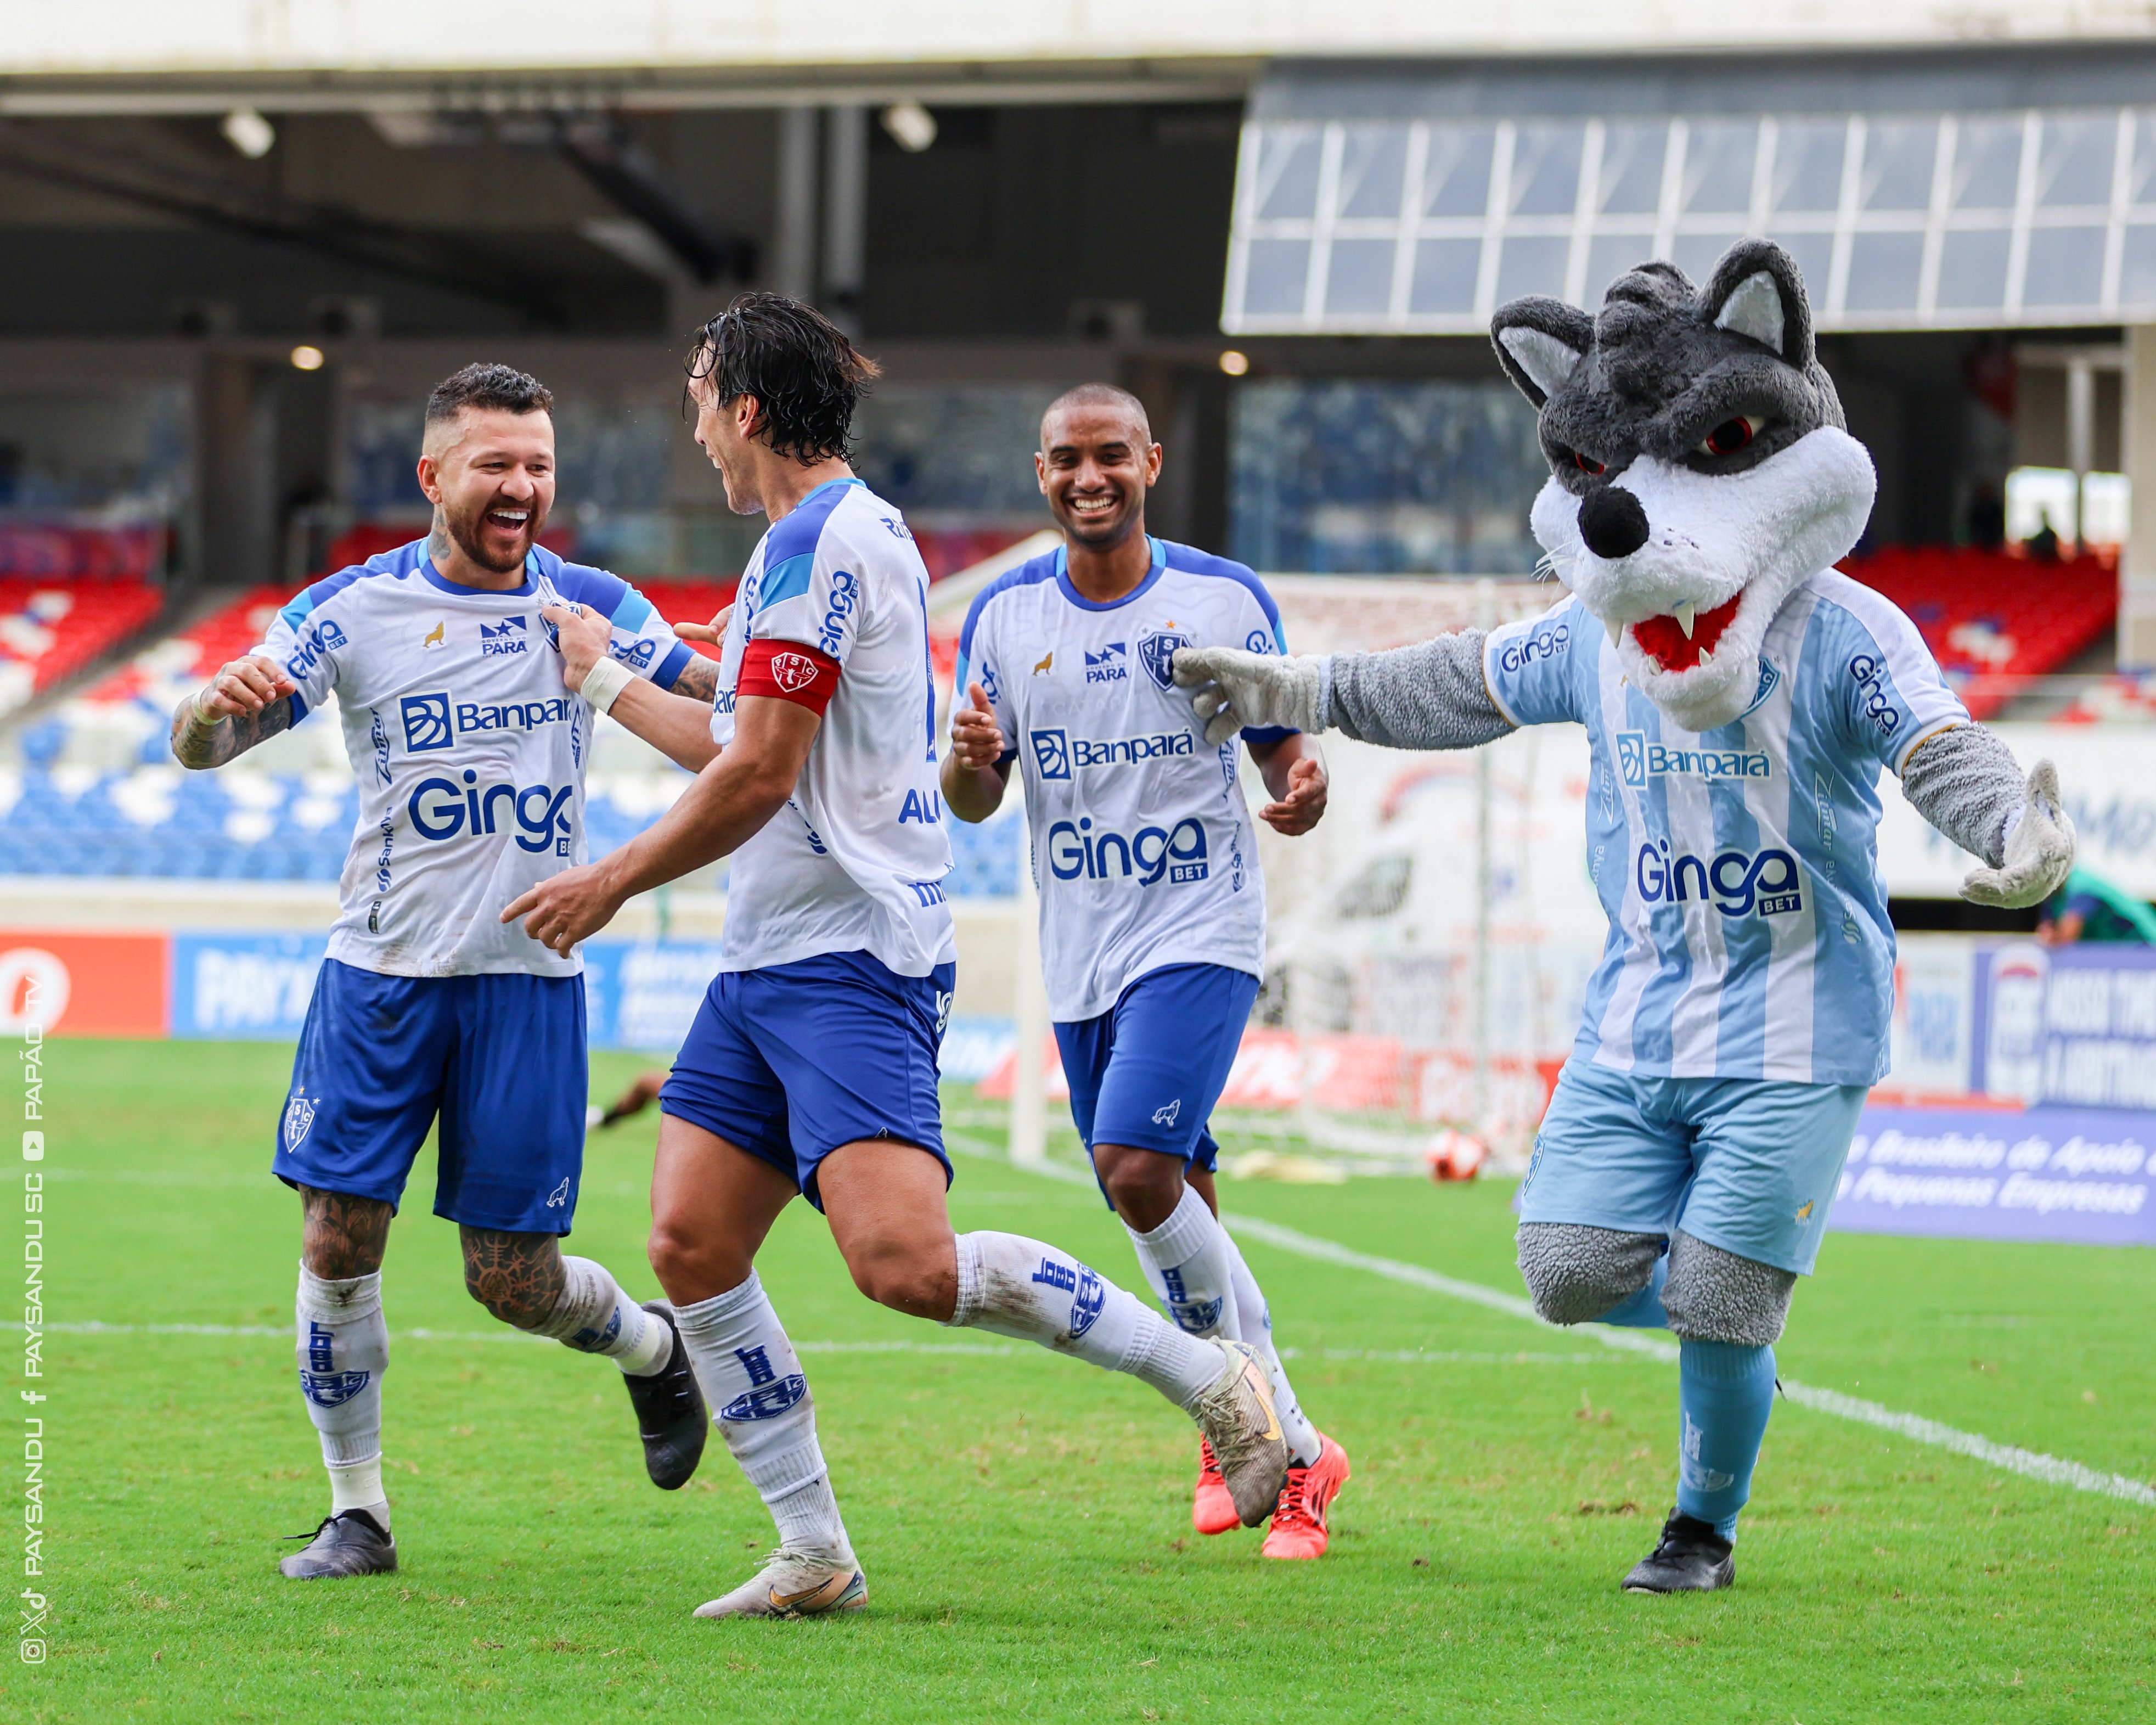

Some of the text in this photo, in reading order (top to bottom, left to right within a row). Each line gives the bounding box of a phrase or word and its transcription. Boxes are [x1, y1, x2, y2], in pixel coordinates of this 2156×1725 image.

[631, 656, 648, 668] BET
[1501, 625, 1569, 672] Ginga
[1073, 728, 1194, 767] Banpará
[1647, 750, 1770, 778] Banpará
[1049, 817, 1207, 887] Ginga
[1174, 865, 1204, 881] BET
[1637, 839, 1799, 917] Ginga
[1763, 896, 1795, 913] BET
